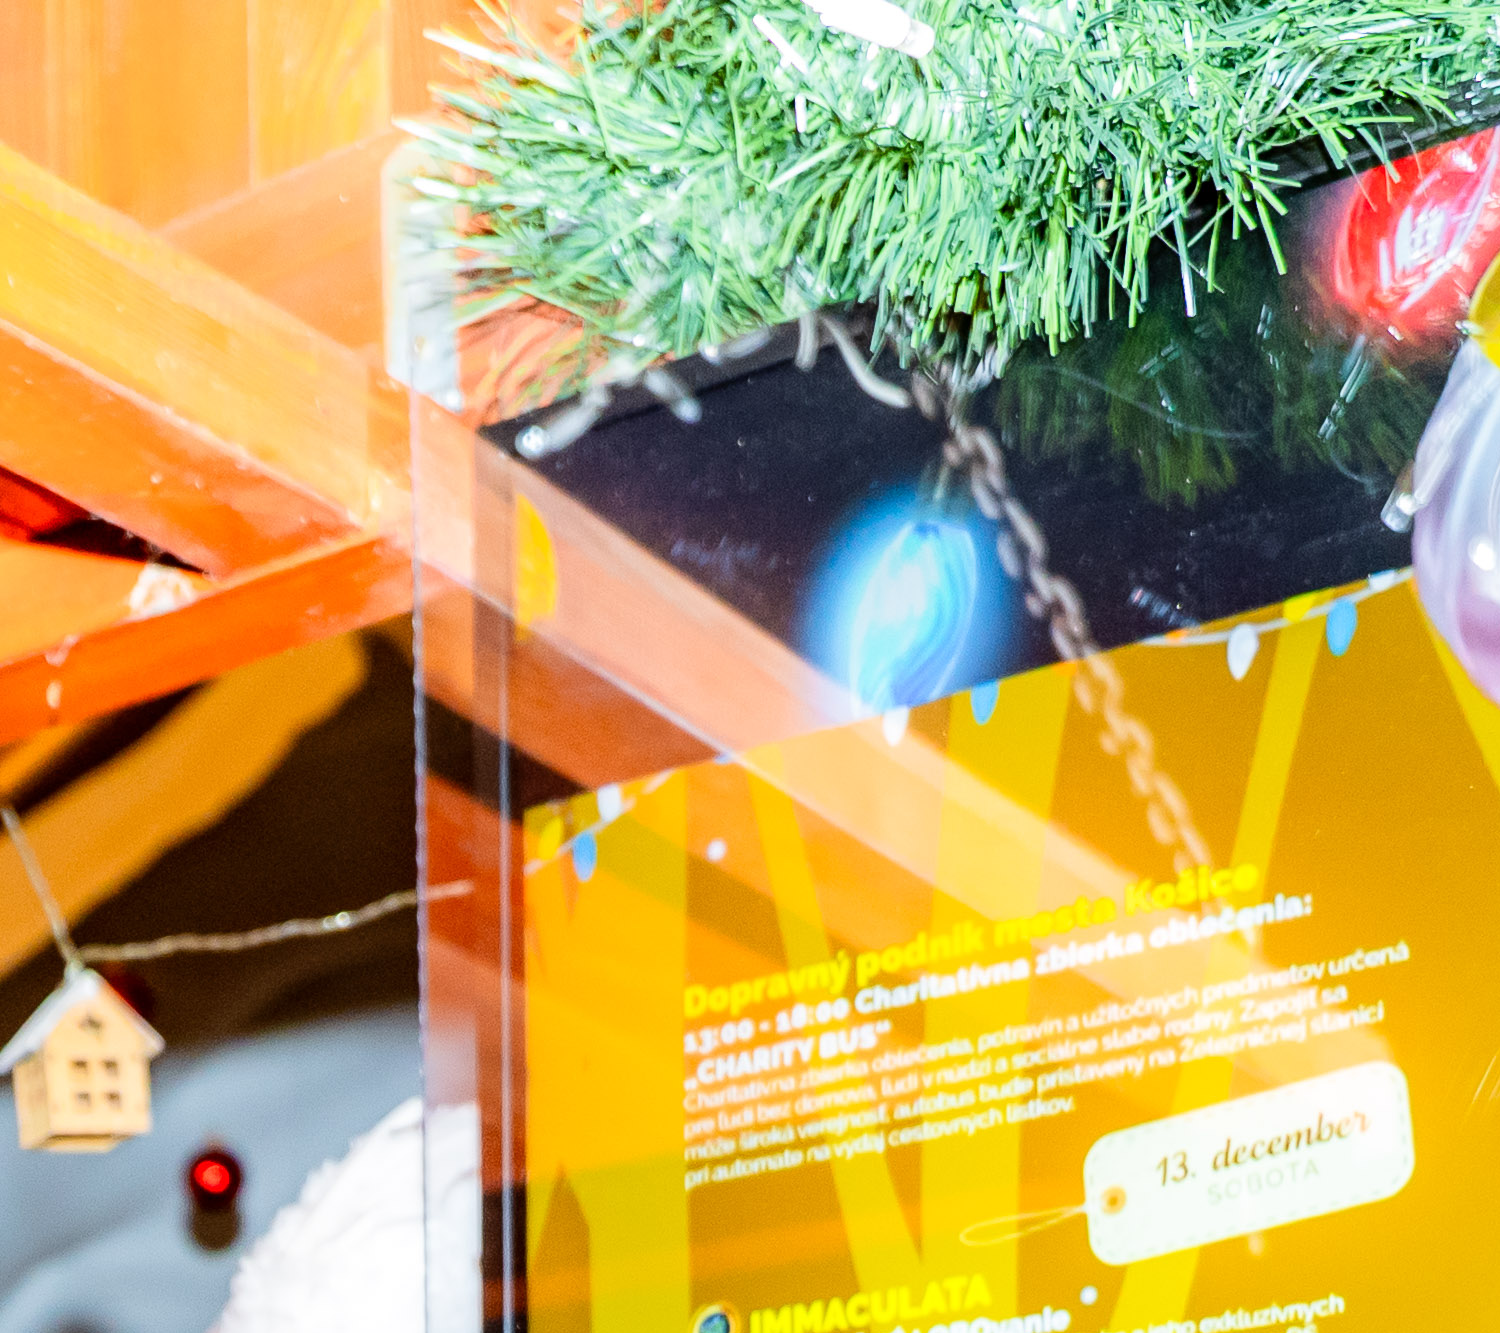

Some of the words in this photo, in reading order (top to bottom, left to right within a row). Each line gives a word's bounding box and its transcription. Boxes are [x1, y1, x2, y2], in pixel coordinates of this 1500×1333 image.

[683, 1019, 755, 1055] 13:00
[776, 998, 850, 1033] 18:00
[854, 959, 1030, 1013] Charitatívna
[1035, 932, 1144, 974] zbierka
[1149, 894, 1312, 948] oblečenia:
[685, 954, 849, 1017] Dopravný
[857, 923, 981, 982] podnik
[996, 899, 1114, 945] mesta
[1127, 864, 1257, 916] Košice
[1155, 1151, 1198, 1189] 13.
[1210, 1109, 1372, 1175] december
[1206, 1160, 1321, 1207] SOBOTA
